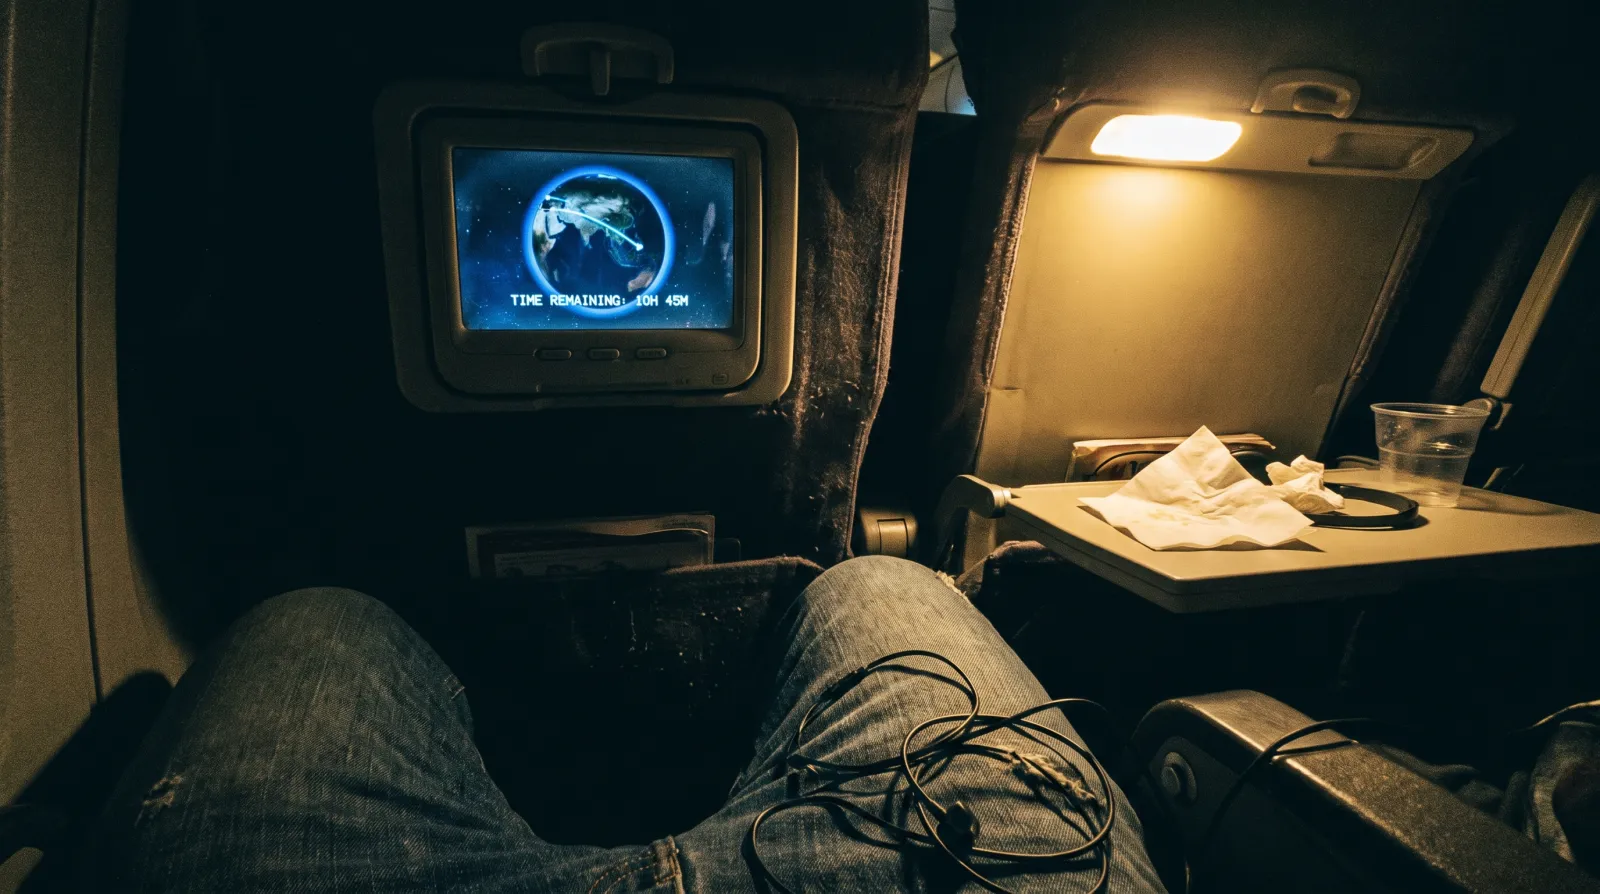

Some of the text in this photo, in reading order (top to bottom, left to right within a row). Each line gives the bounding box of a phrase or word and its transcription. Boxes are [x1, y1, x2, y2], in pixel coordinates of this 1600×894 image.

[510, 294, 689, 306] TIME REMAINING: 10H 45M
